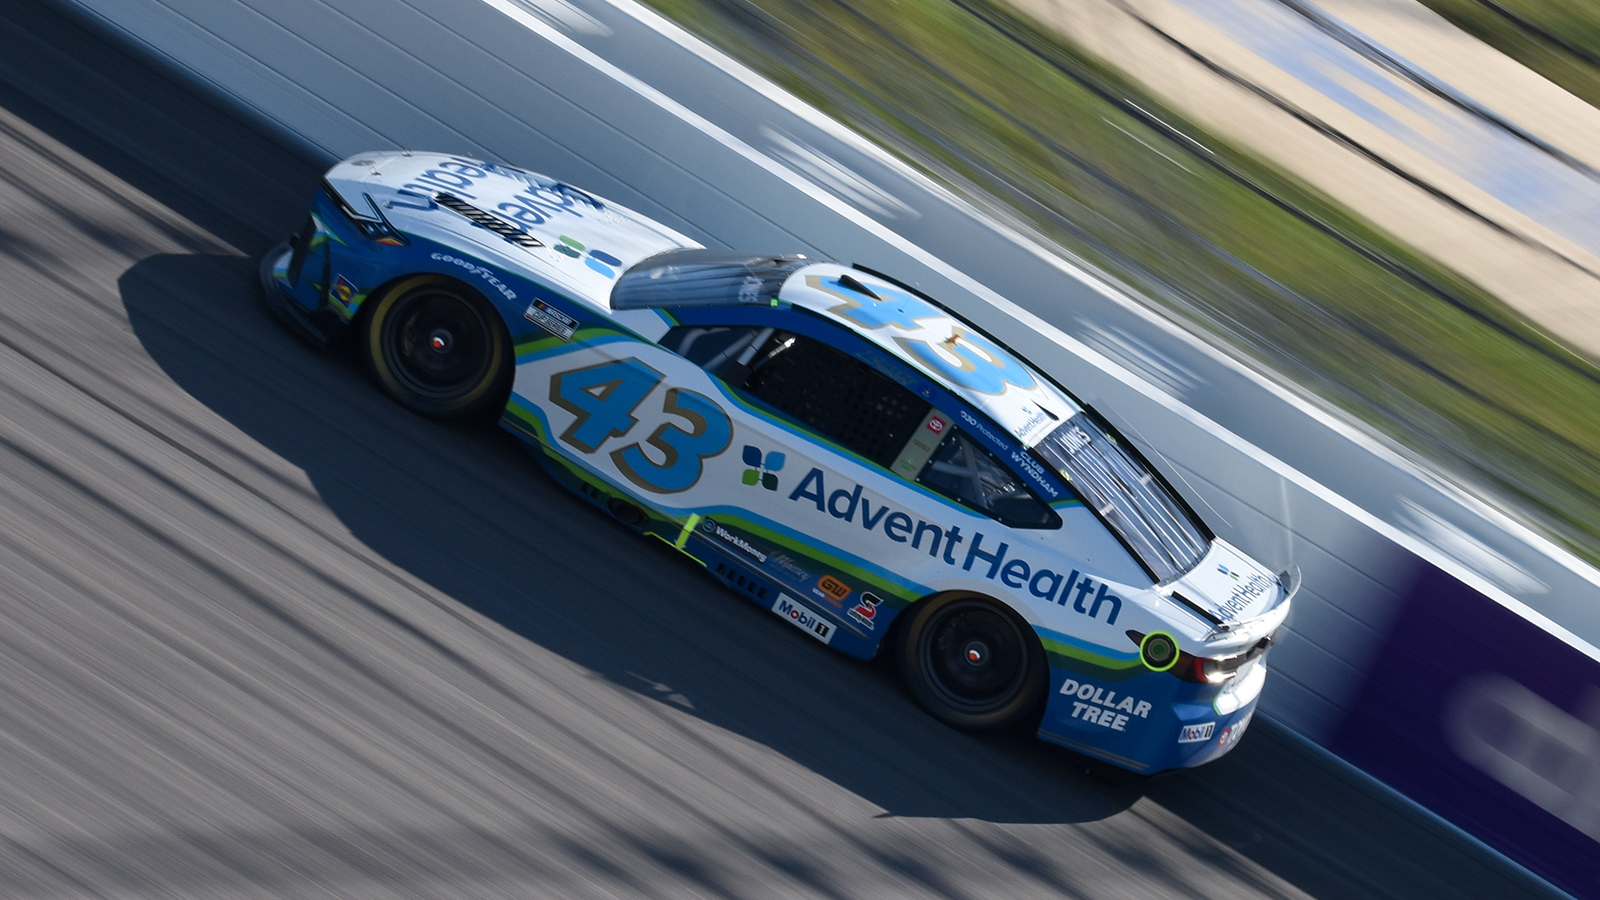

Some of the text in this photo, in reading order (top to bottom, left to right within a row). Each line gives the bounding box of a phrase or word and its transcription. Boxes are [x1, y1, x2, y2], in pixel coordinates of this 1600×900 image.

[430, 252, 517, 301] GOODYEAR
[805, 275, 1037, 396] 43
[549, 357, 734, 494] 43
[976, 423, 1009, 450] Protected
[1011, 452, 1059, 498] WYNDHAM
[1020, 451, 1044, 475] CLUB
[716, 526, 767, 563] WorkMoney
[788, 467, 1123, 625] AdventHealth
[778, 600, 816, 630] Mobil
[1209, 573, 1274, 623] AdventHealth
[1060, 679, 1152, 718] DOLLAR
[1071, 702, 1129, 732] TREE
[1180, 725, 1204, 742] Mobil
